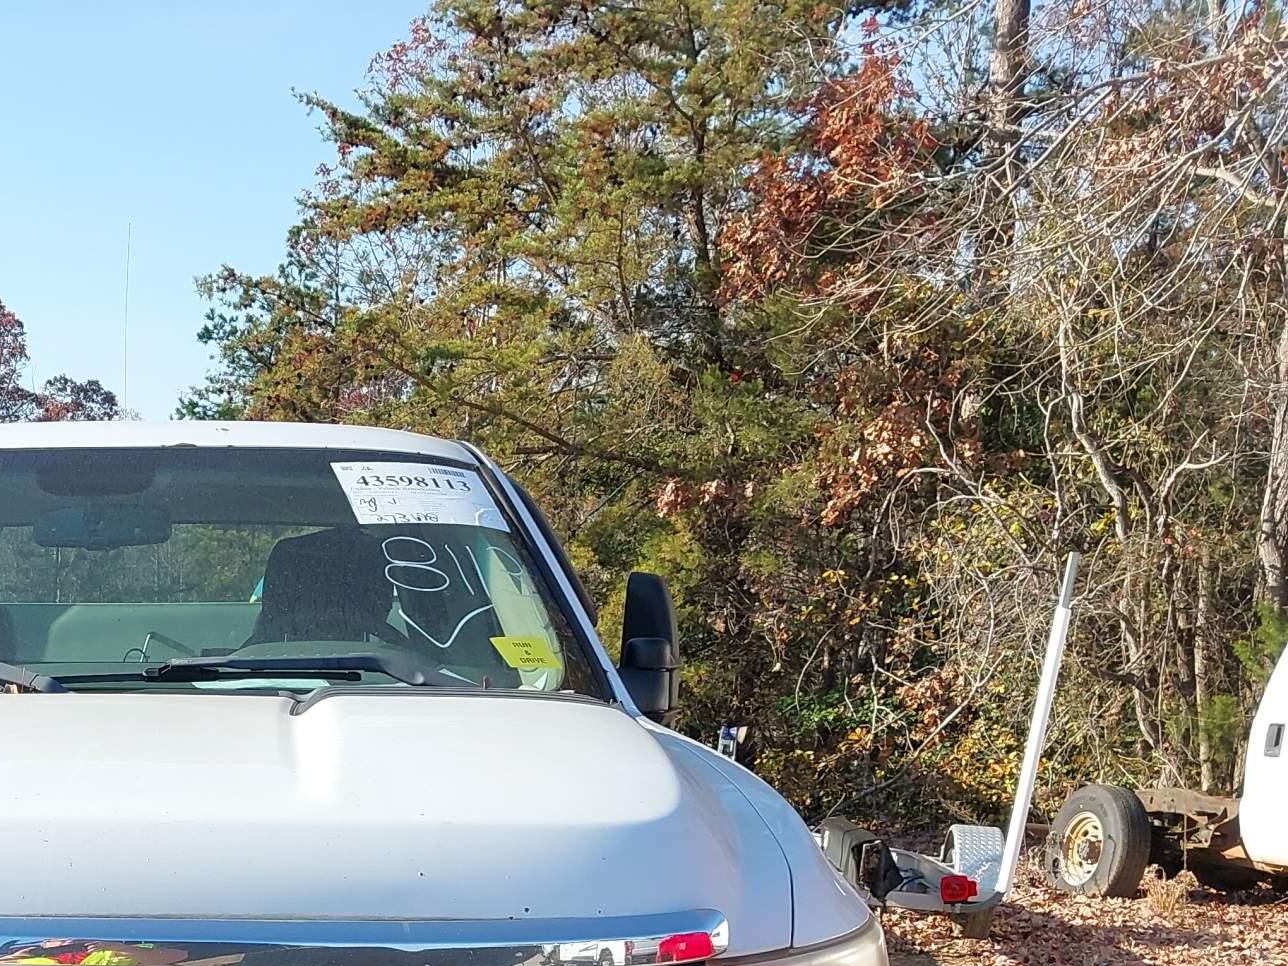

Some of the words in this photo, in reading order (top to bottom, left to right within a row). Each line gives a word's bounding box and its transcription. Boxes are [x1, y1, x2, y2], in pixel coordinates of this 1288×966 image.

[355, 475, 472, 492] 43598113
[511, 641, 533, 649] RUN
[519, 657, 548, 665] DRIVE
